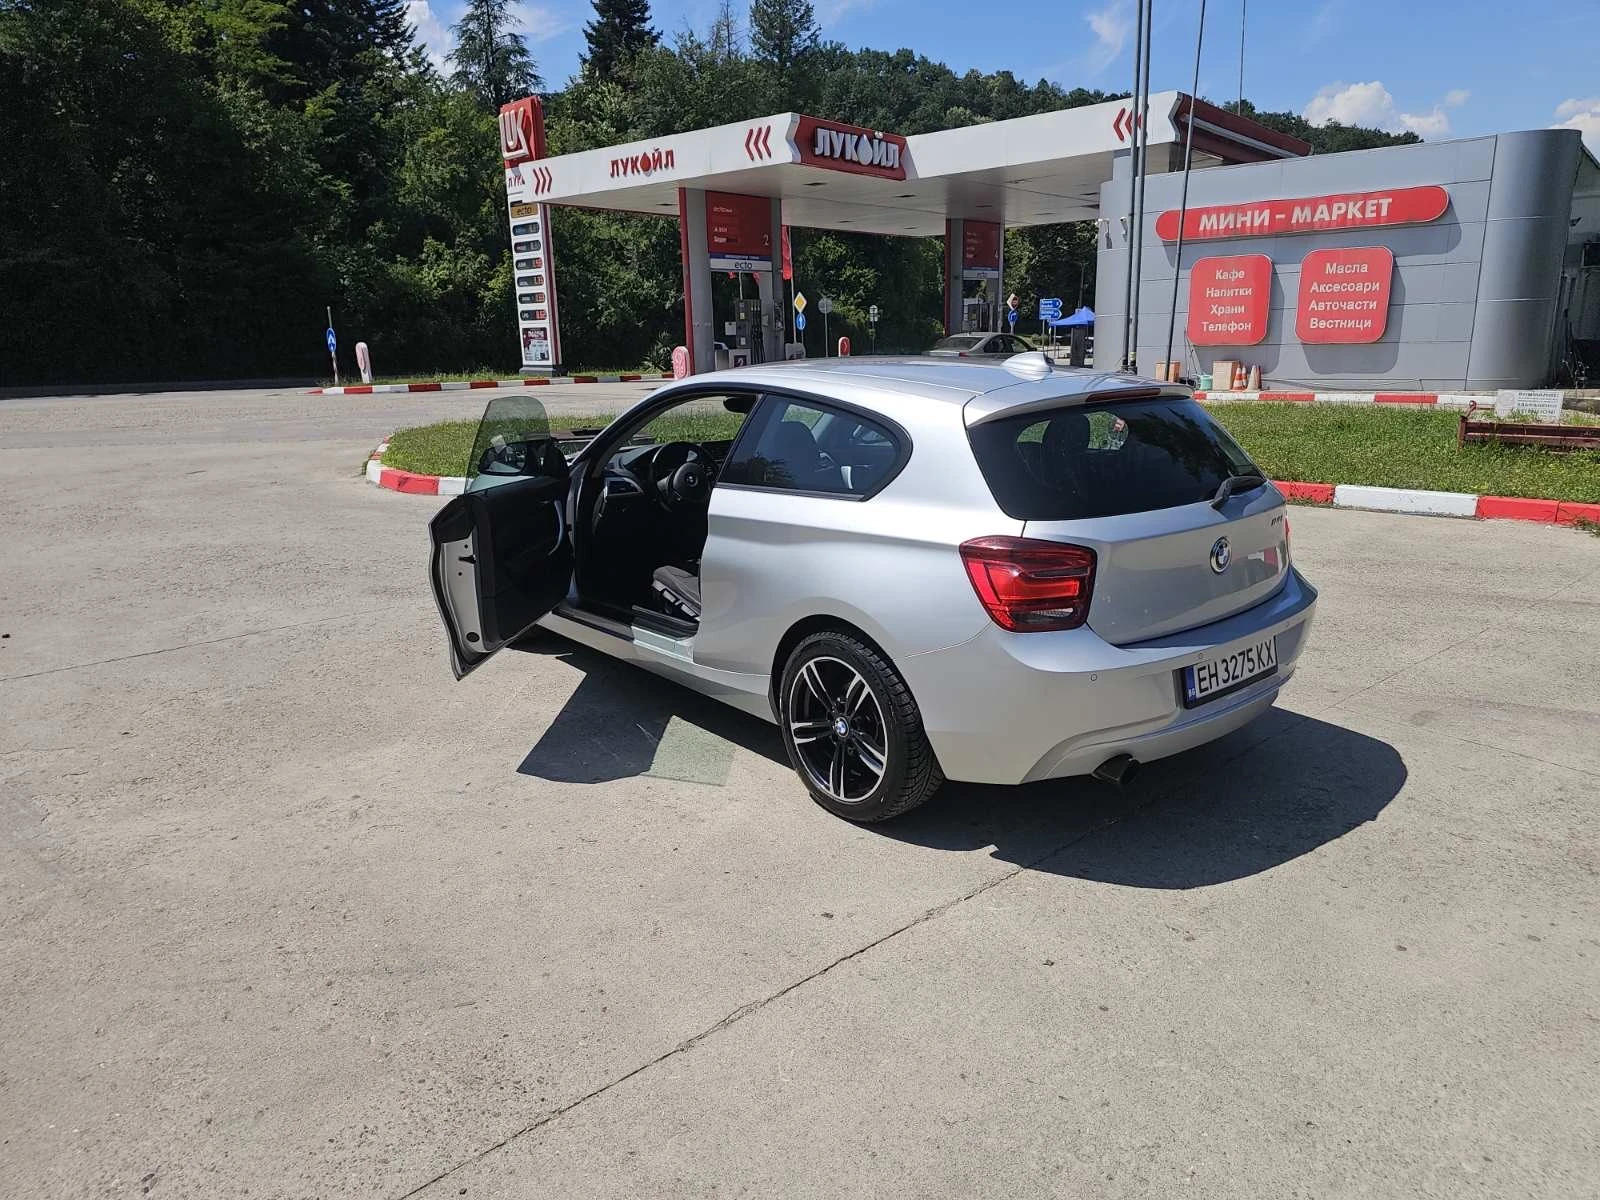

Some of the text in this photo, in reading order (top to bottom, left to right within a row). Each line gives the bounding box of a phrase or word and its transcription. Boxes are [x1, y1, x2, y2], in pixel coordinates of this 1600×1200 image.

[815, 127, 900, 169] ЛУКОЙЛ
[610, 147, 675, 178] ЛУКОЙЛ
[1199, 208, 1270, 231] МИНИ
[1291, 198, 1393, 224] МАРКЕТ
[1215, 268, 1245, 282] Кафе
[1325, 262, 1368, 275] Масла
[1206, 286, 1252, 298] Напитки
[1310, 281, 1380, 294] Аксесоари
[1210, 304, 1245, 316] Храни
[1309, 299, 1377, 311] Авточасти
[1201, 321, 1251, 333] Телефон
[1309, 317, 1372, 330] Вестници
